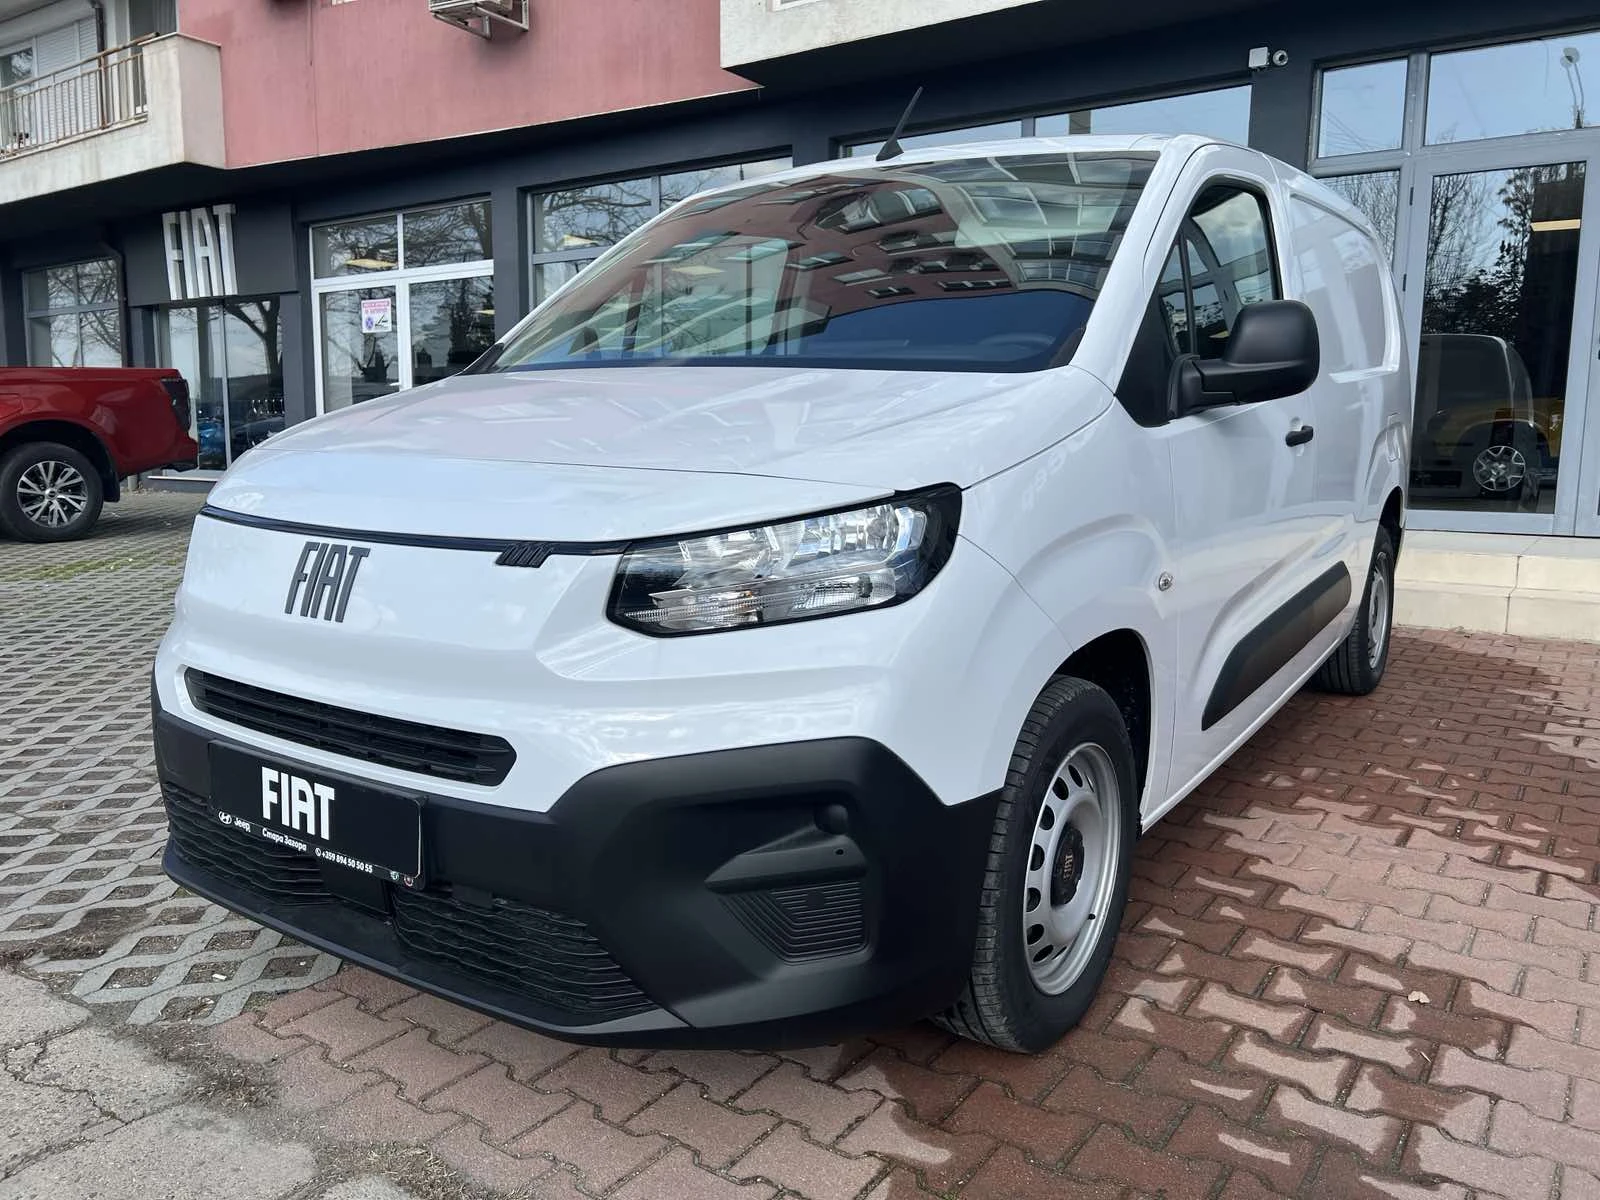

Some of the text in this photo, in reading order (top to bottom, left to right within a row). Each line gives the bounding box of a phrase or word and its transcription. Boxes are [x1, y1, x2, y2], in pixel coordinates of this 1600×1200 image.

[162, 203, 238, 300] FIAT
[284, 541, 371, 623] FIAT
[234, 817, 251, 832] Jeep
[261, 766, 335, 841] FIAT
[321, 850, 373, 873] +359 894 50 50 55
